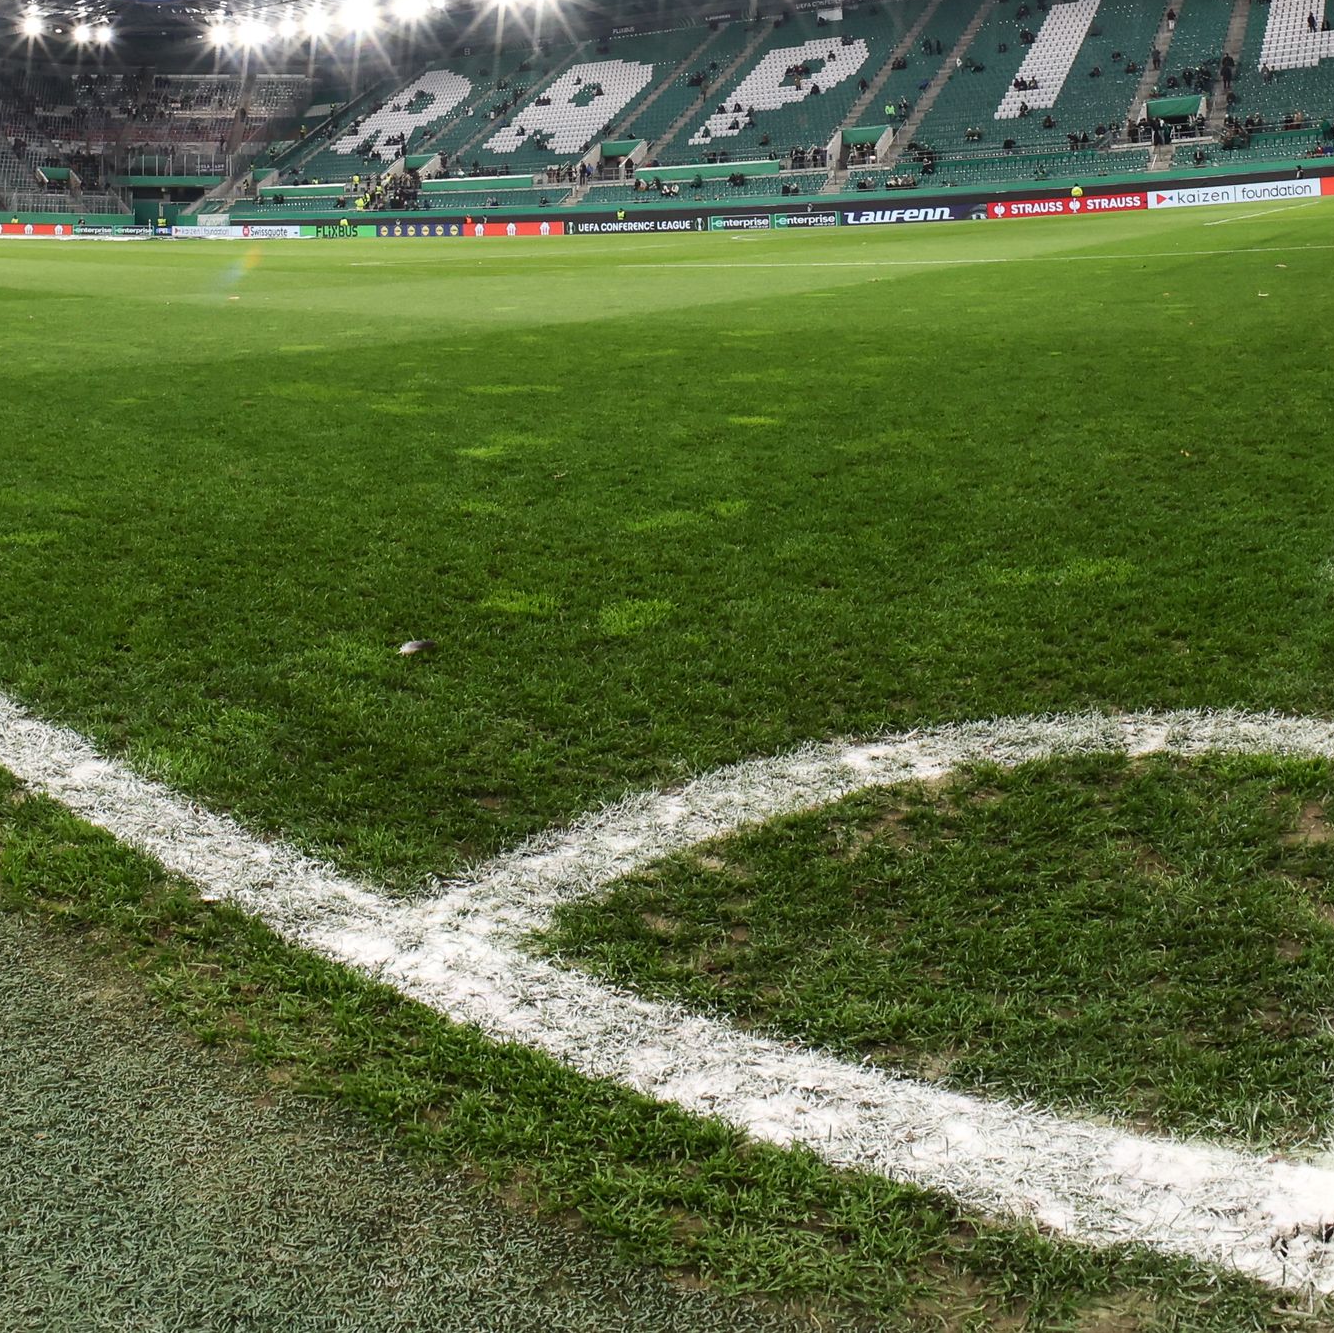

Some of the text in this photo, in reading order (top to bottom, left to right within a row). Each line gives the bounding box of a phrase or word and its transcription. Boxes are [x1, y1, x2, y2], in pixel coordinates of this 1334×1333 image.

[1177, 183, 1312, 204] kaizen foundation
[1010, 200, 1063, 215] STRAUSS
[1086, 196, 1141, 210] STRAUSS
[578, 220, 691, 232] UEFA CONFERENCE LEAGUE
[713, 217, 769, 229] enterprise
[776, 214, 836, 226] enterprise
[75, 226, 112, 235] enterprise
[250, 227, 288, 237] Swissquote
